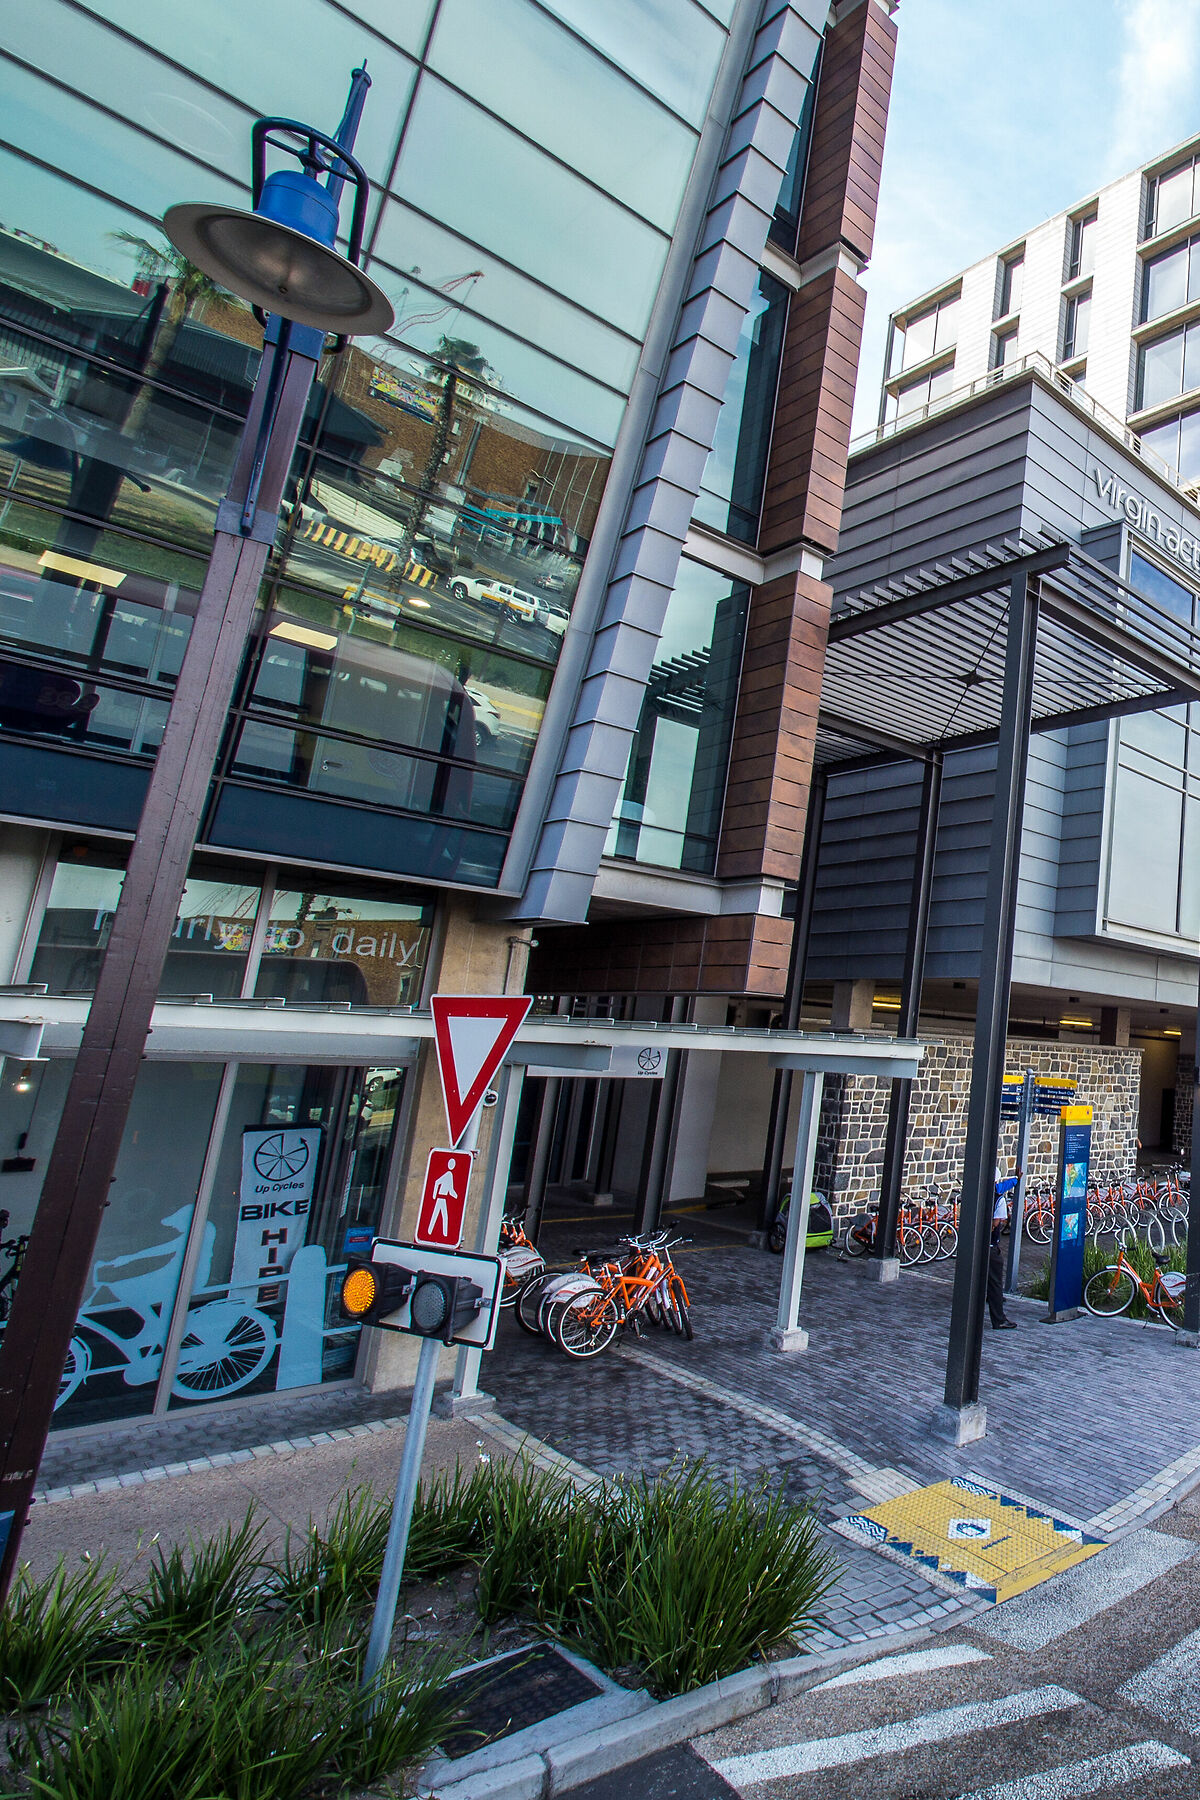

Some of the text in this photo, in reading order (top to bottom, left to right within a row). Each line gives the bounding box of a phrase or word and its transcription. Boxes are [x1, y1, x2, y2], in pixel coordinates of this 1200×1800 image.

[1094, 467, 1162, 541] virgin
[331, 927, 418, 967] daily
[255, 1181, 305, 1194] Up Cycles
[240, 1199, 310, 1222] BIKE
